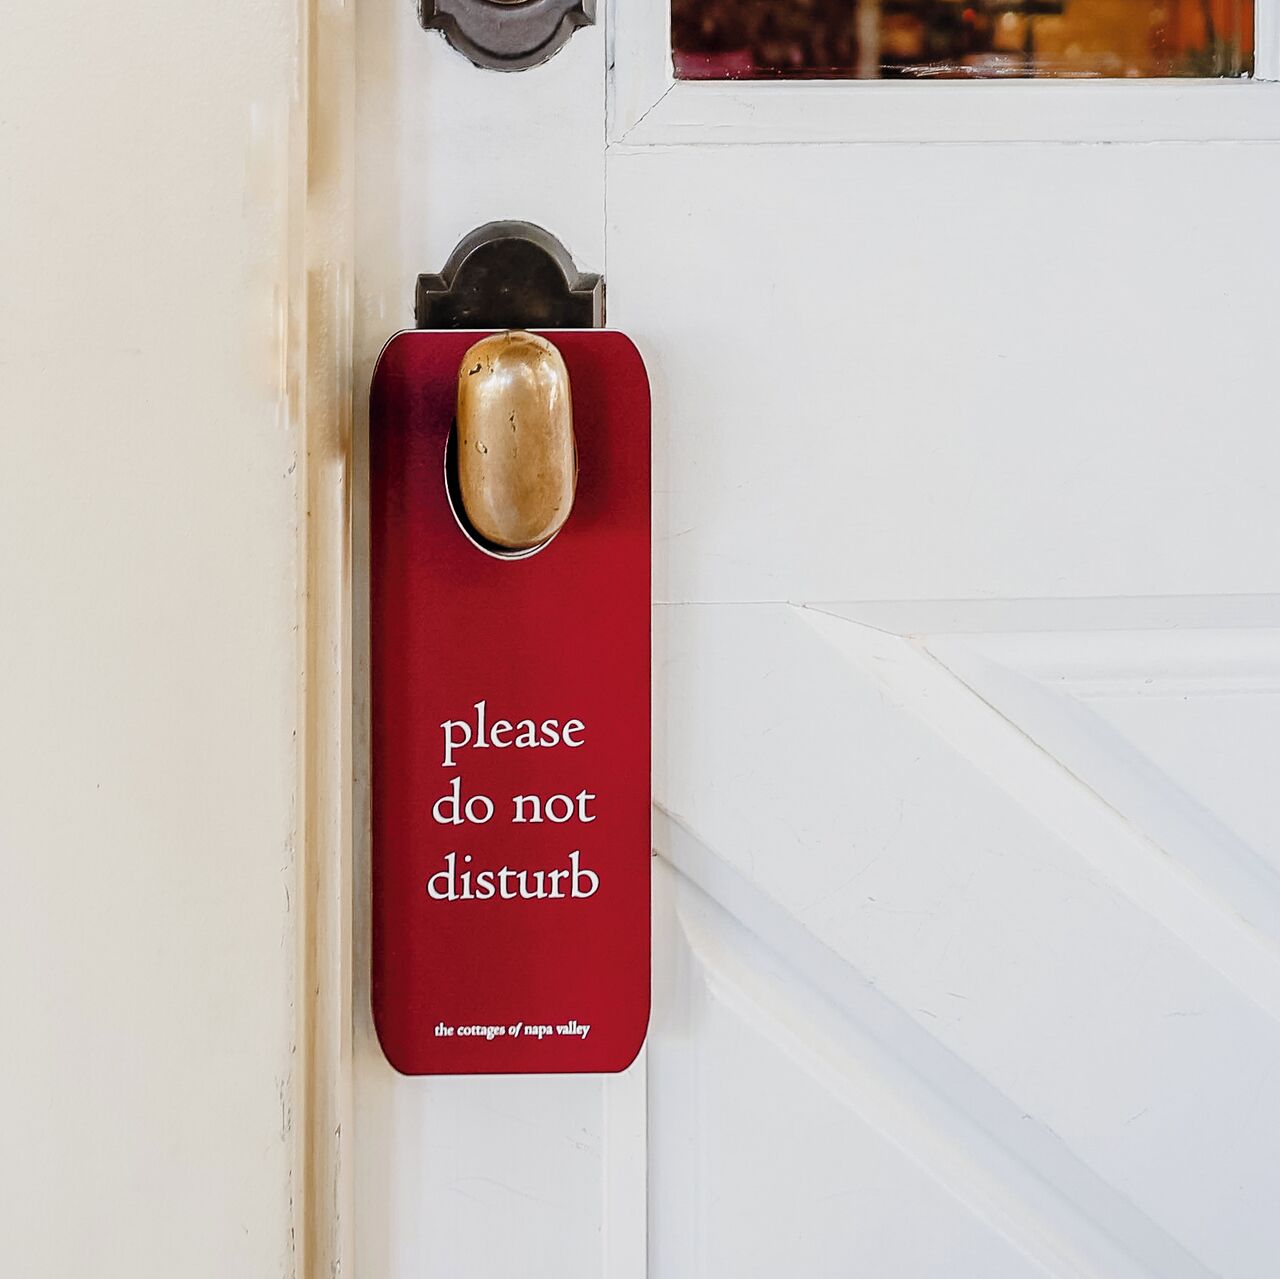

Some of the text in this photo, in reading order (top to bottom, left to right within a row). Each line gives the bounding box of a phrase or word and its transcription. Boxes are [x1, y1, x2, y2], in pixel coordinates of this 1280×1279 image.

[440, 700, 585, 766] please
[432, 776, 596, 825] do not
[427, 850, 600, 901] disturb
[434, 1020, 591, 1040] the cottages of napa valley
